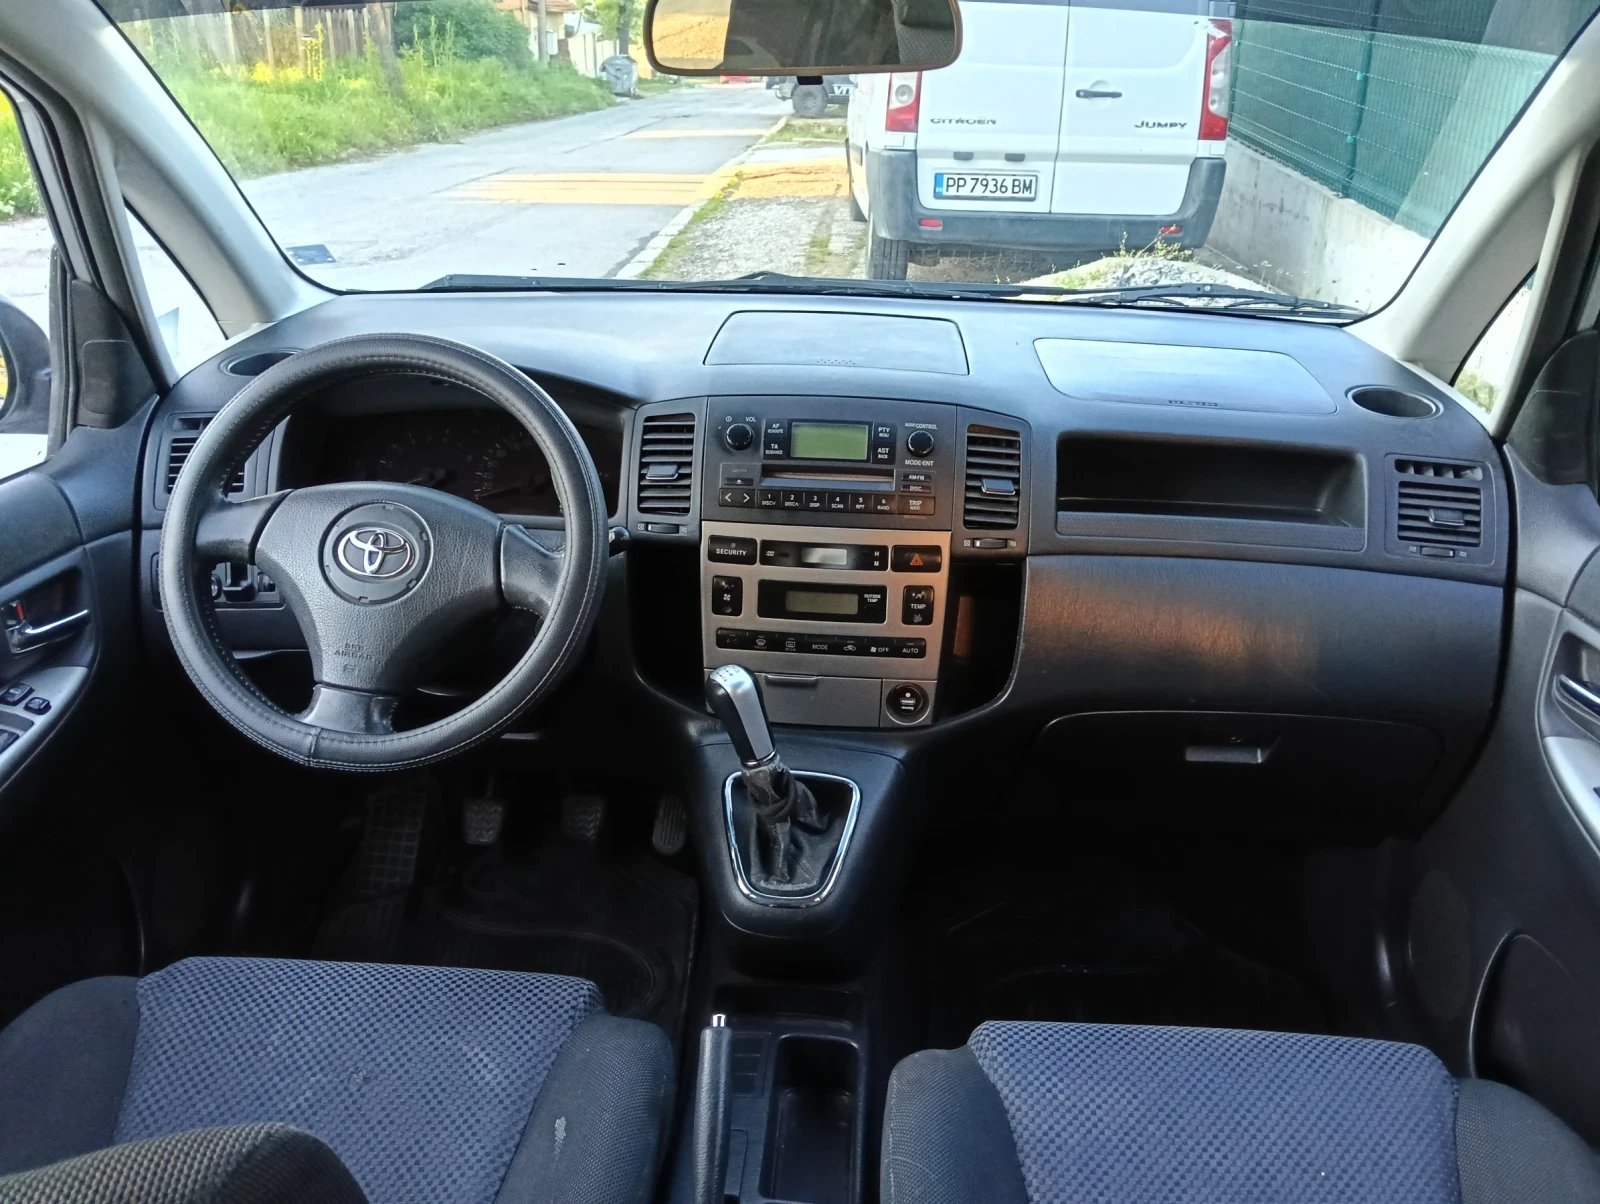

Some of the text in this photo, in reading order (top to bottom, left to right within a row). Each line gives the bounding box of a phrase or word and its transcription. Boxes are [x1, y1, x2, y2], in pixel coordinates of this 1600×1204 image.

[1134, 120, 1187, 129] JUMPY
[945, 177, 1033, 194] PP 7936 BM
[482, 482, 492, 490] 20
[715, 548, 747, 556] SECURITY
